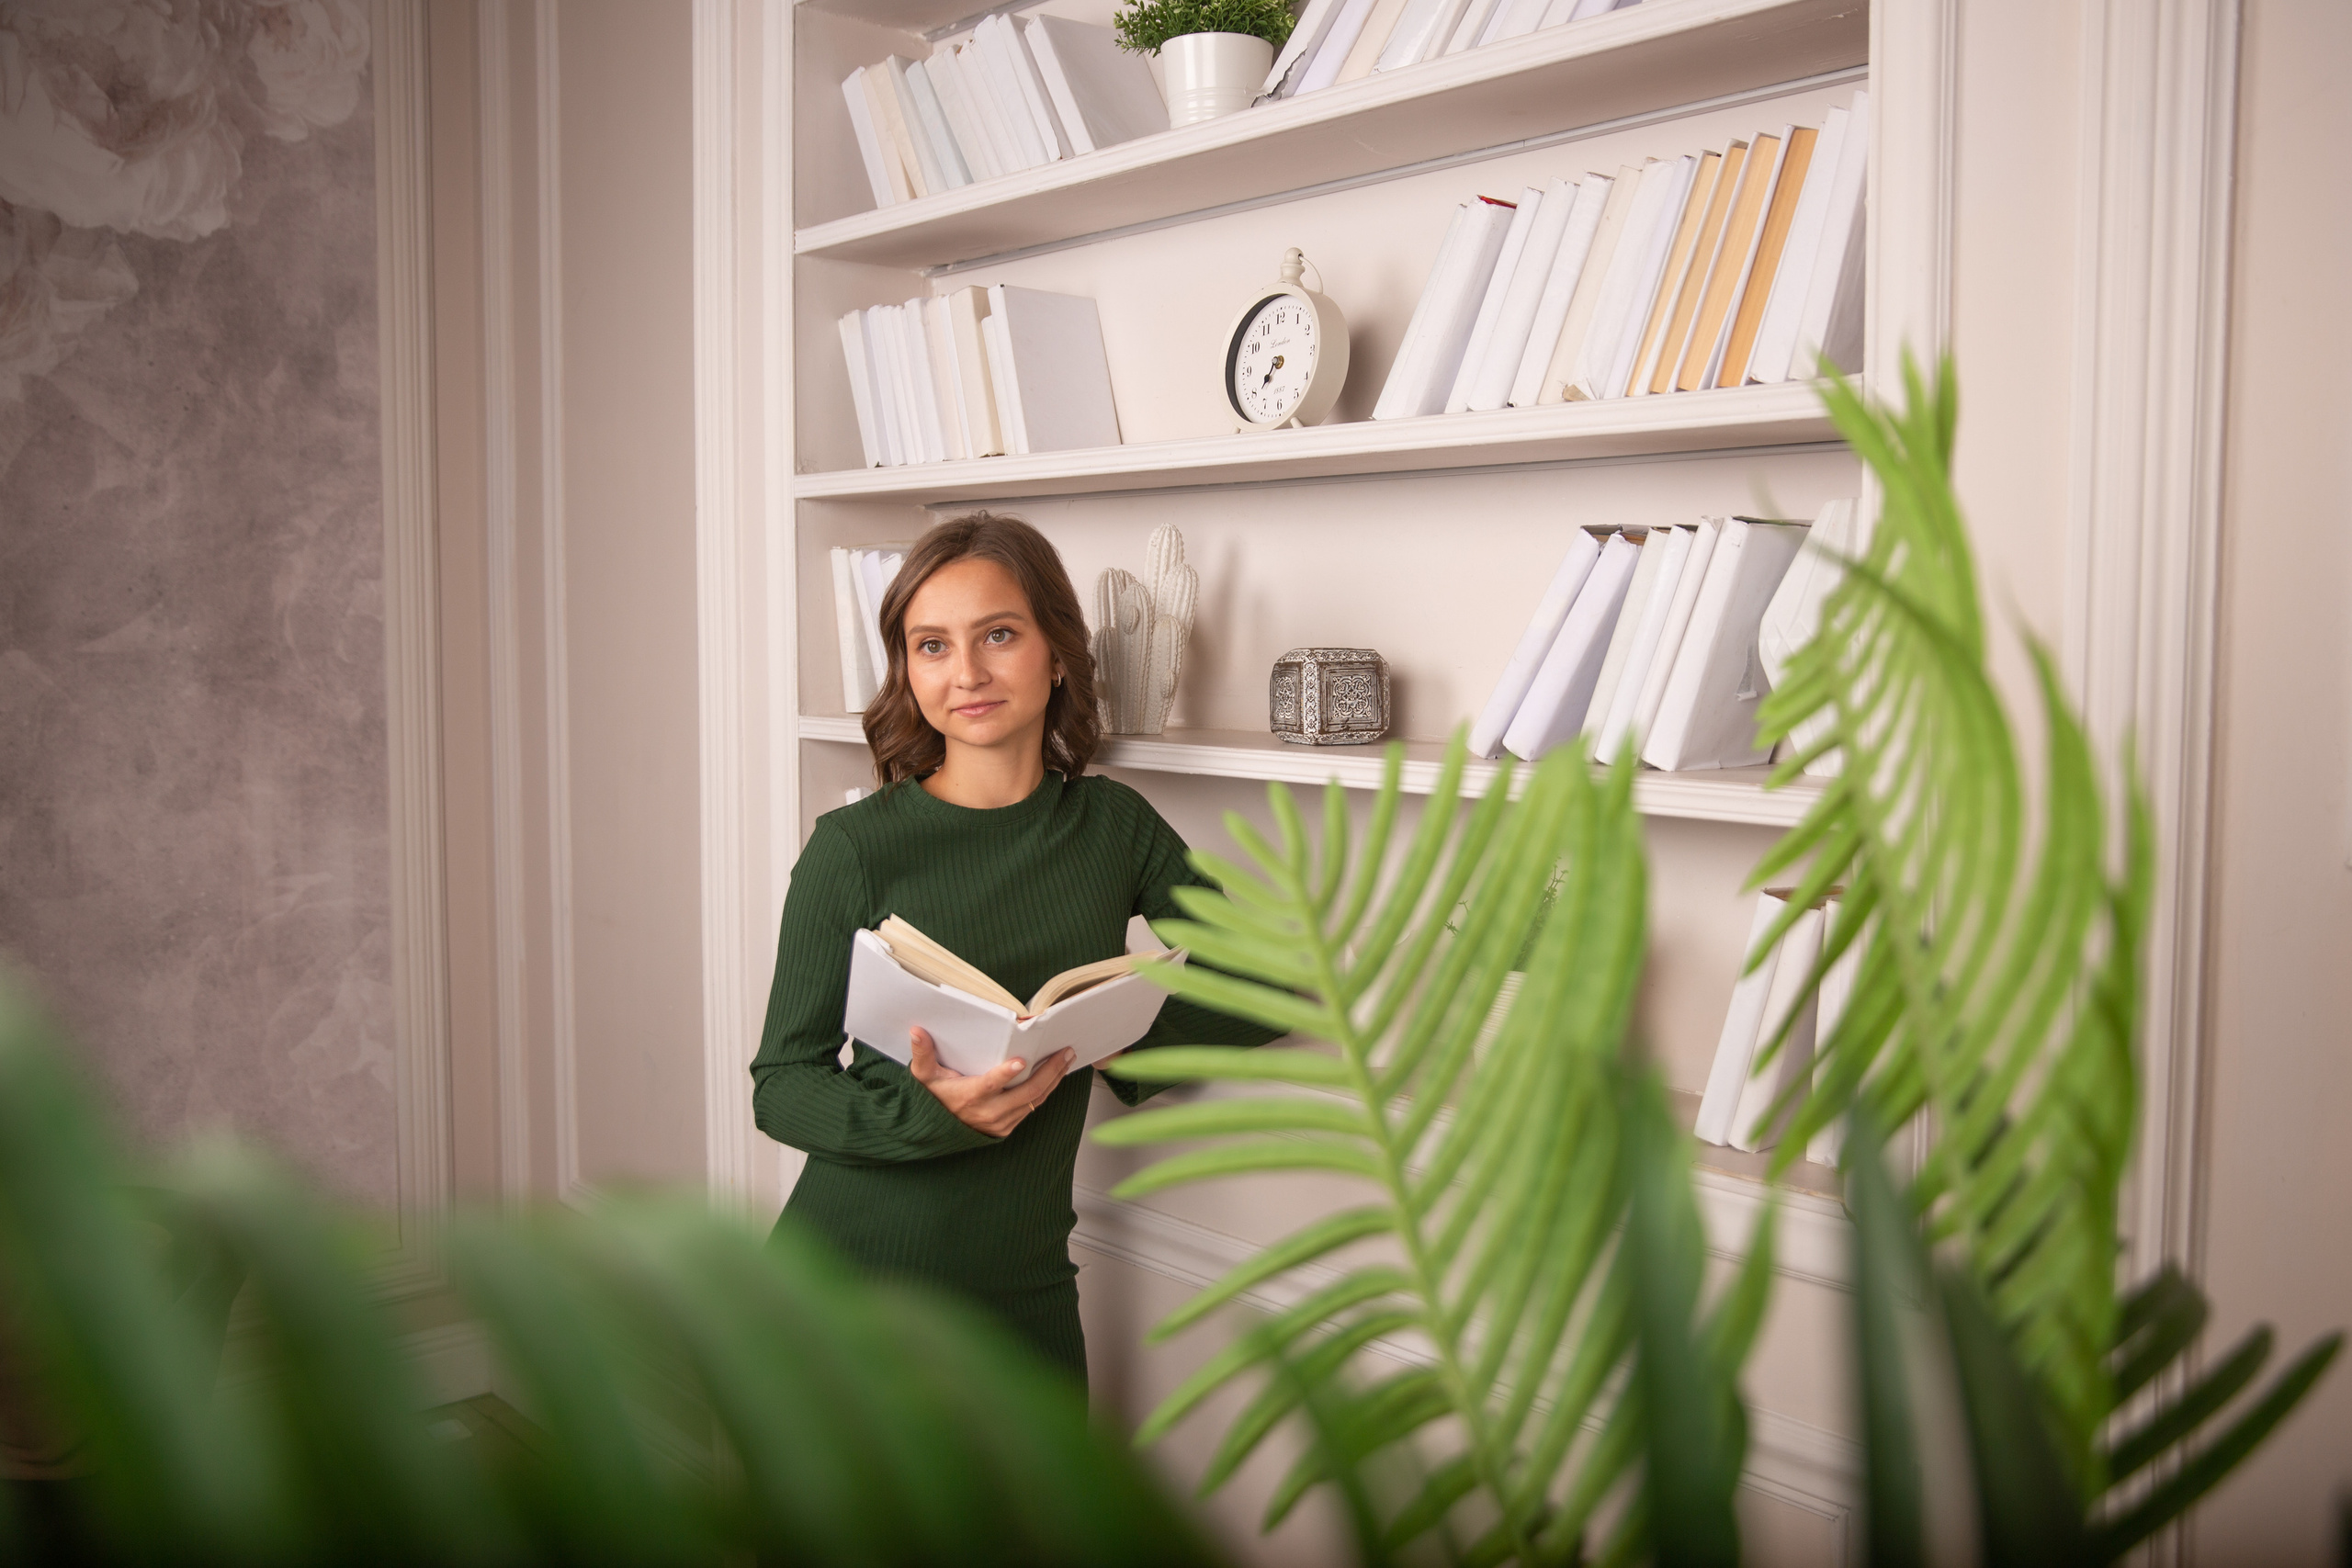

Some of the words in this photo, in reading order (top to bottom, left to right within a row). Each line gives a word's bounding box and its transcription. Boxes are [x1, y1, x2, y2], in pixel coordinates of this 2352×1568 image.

[1276, 311, 1284, 324] 12
[1295, 313, 1300, 324] 1
[1262, 323, 1270, 336] 11
[1305, 324, 1310, 335] 2
[1251, 342, 1260, 354] 10
[1271, 338, 1291, 348] London
[1310, 344, 1315, 355] 3
[1247, 367, 1251, 377] 9
[1251, 388, 1257, 399] 8
[1294, 389, 1299, 400] 5
[1262, 399, 1267, 409] 7
[1277, 399, 1283, 410] 6
